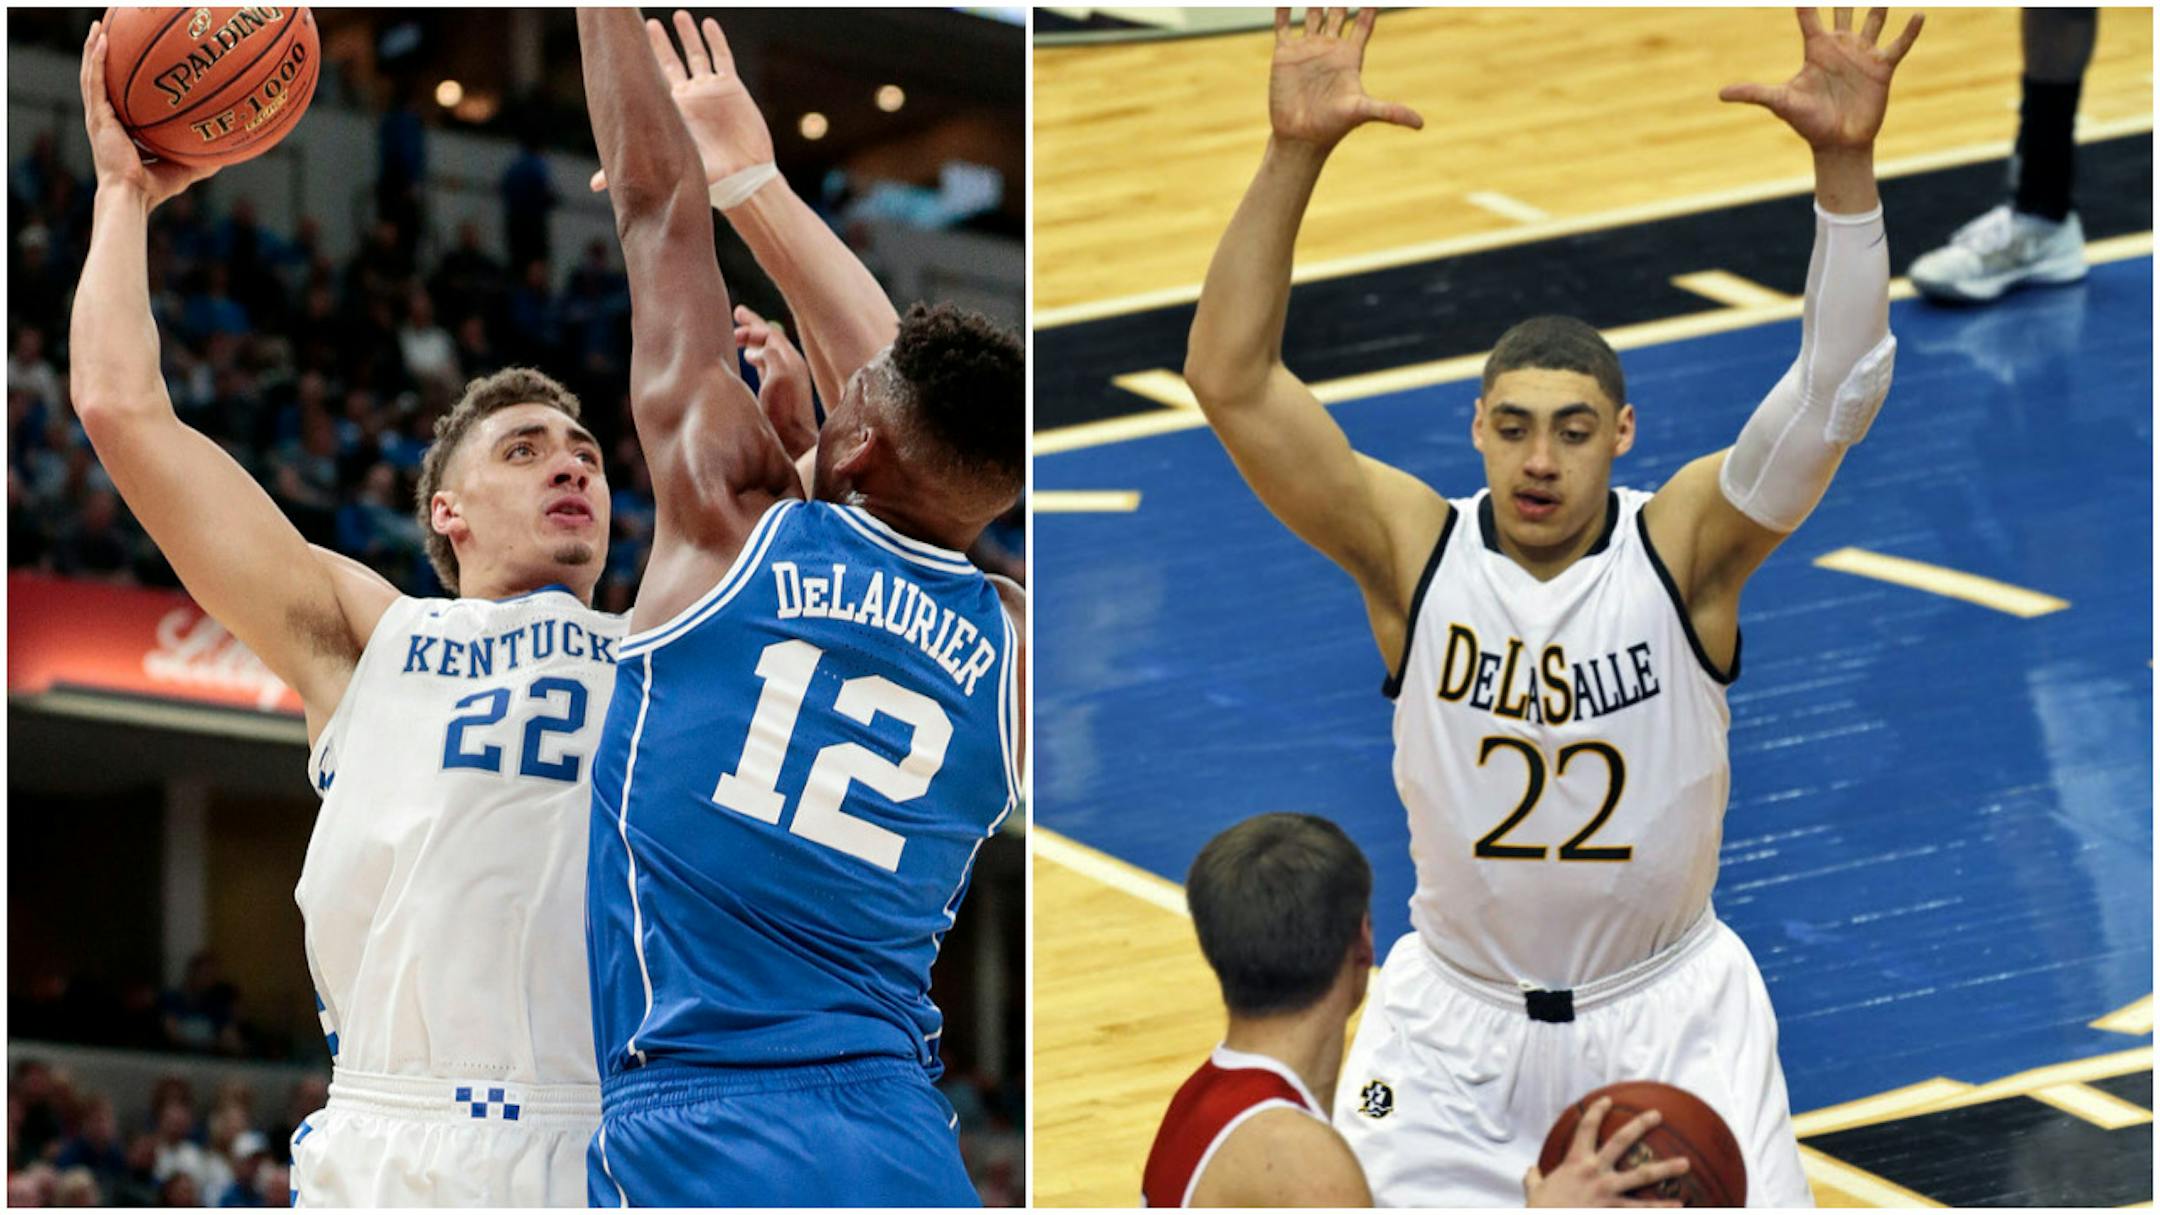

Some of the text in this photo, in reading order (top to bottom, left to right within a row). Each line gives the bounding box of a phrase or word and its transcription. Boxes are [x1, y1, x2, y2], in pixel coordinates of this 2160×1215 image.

[403, 619, 622, 679] KENTUCK
[441, 675, 590, 783] 22
[711, 638, 954, 874] 12
[1472, 735, 1634, 862] 22
